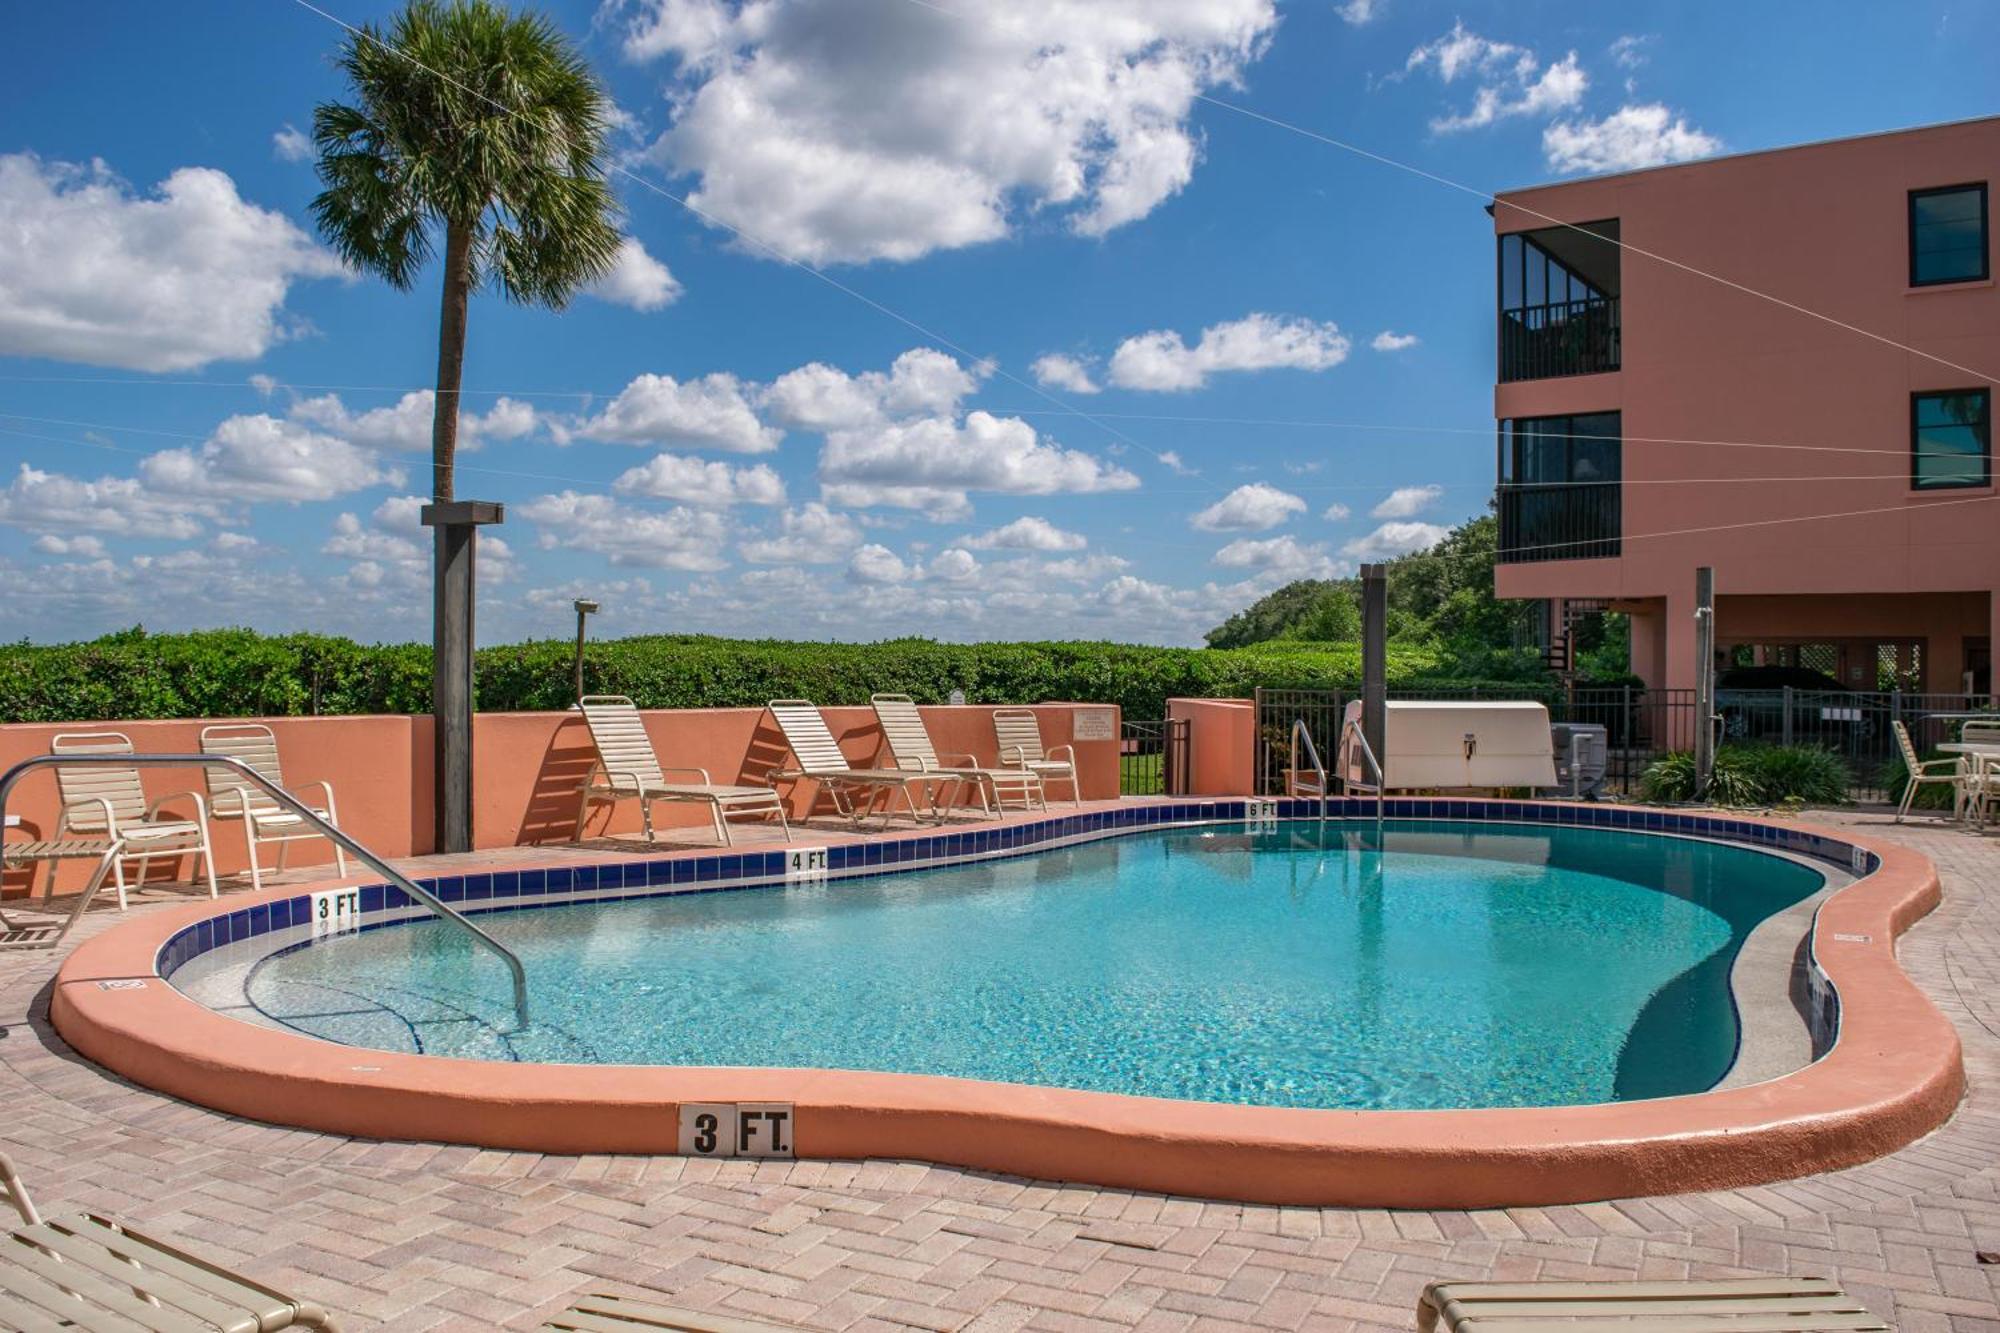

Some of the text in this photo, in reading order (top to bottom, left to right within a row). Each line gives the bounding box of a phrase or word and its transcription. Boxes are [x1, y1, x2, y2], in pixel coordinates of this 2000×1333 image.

[1250, 803, 1257, 817] 6
[792, 853, 801, 870] 4
[319, 892, 358, 919] 3 FT.
[694, 1111, 789, 1153] 3 FT.
